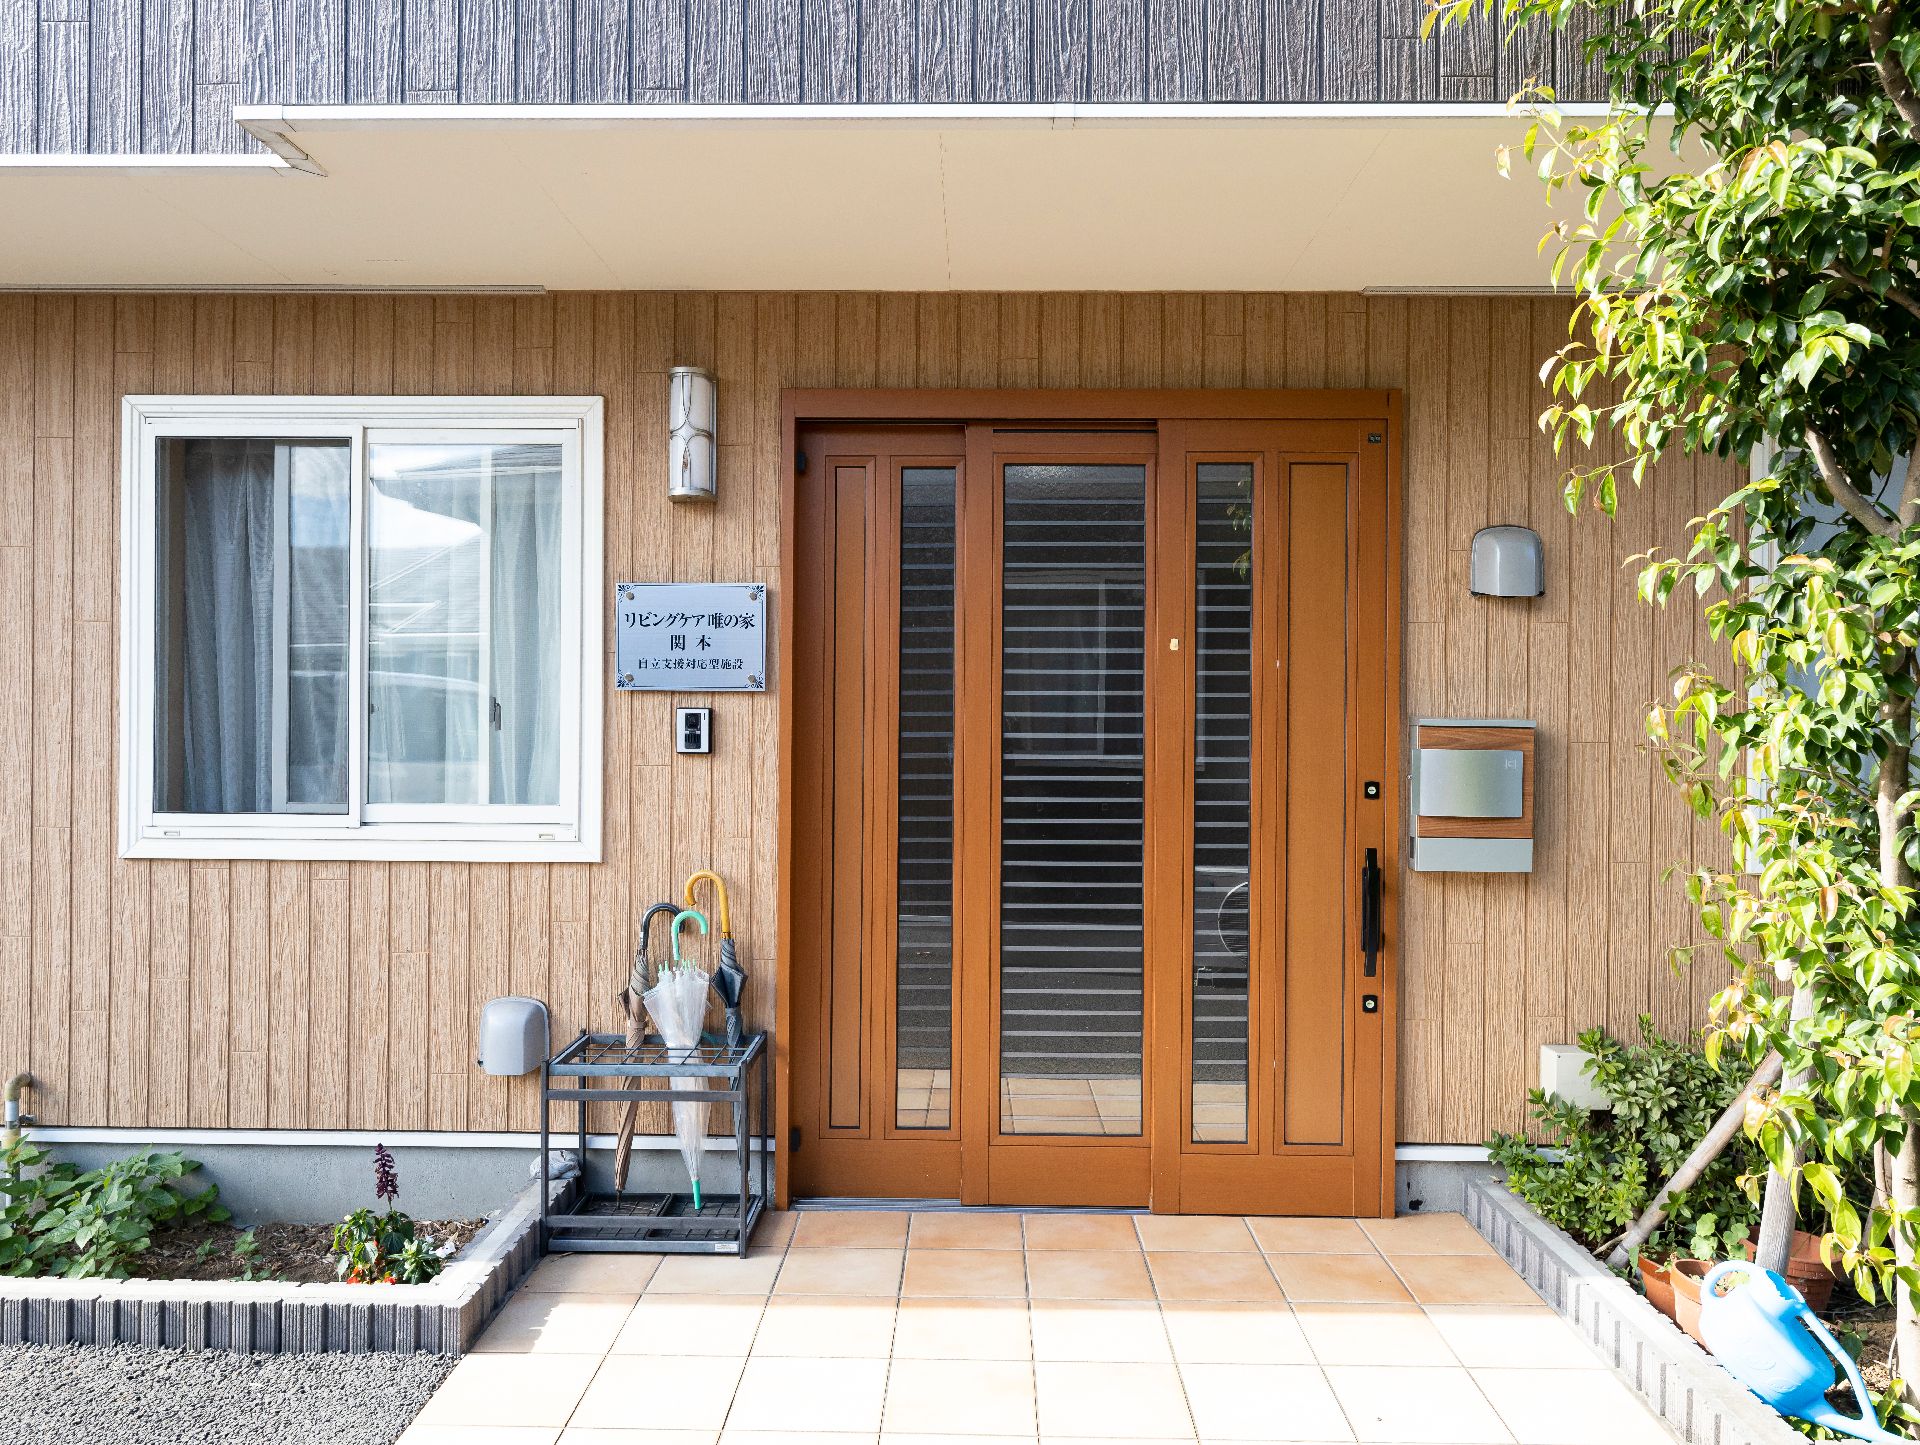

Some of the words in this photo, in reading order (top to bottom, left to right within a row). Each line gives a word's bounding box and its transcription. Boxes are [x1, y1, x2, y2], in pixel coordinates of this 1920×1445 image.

[638, 658, 743, 670] 自立支援対応型施設
